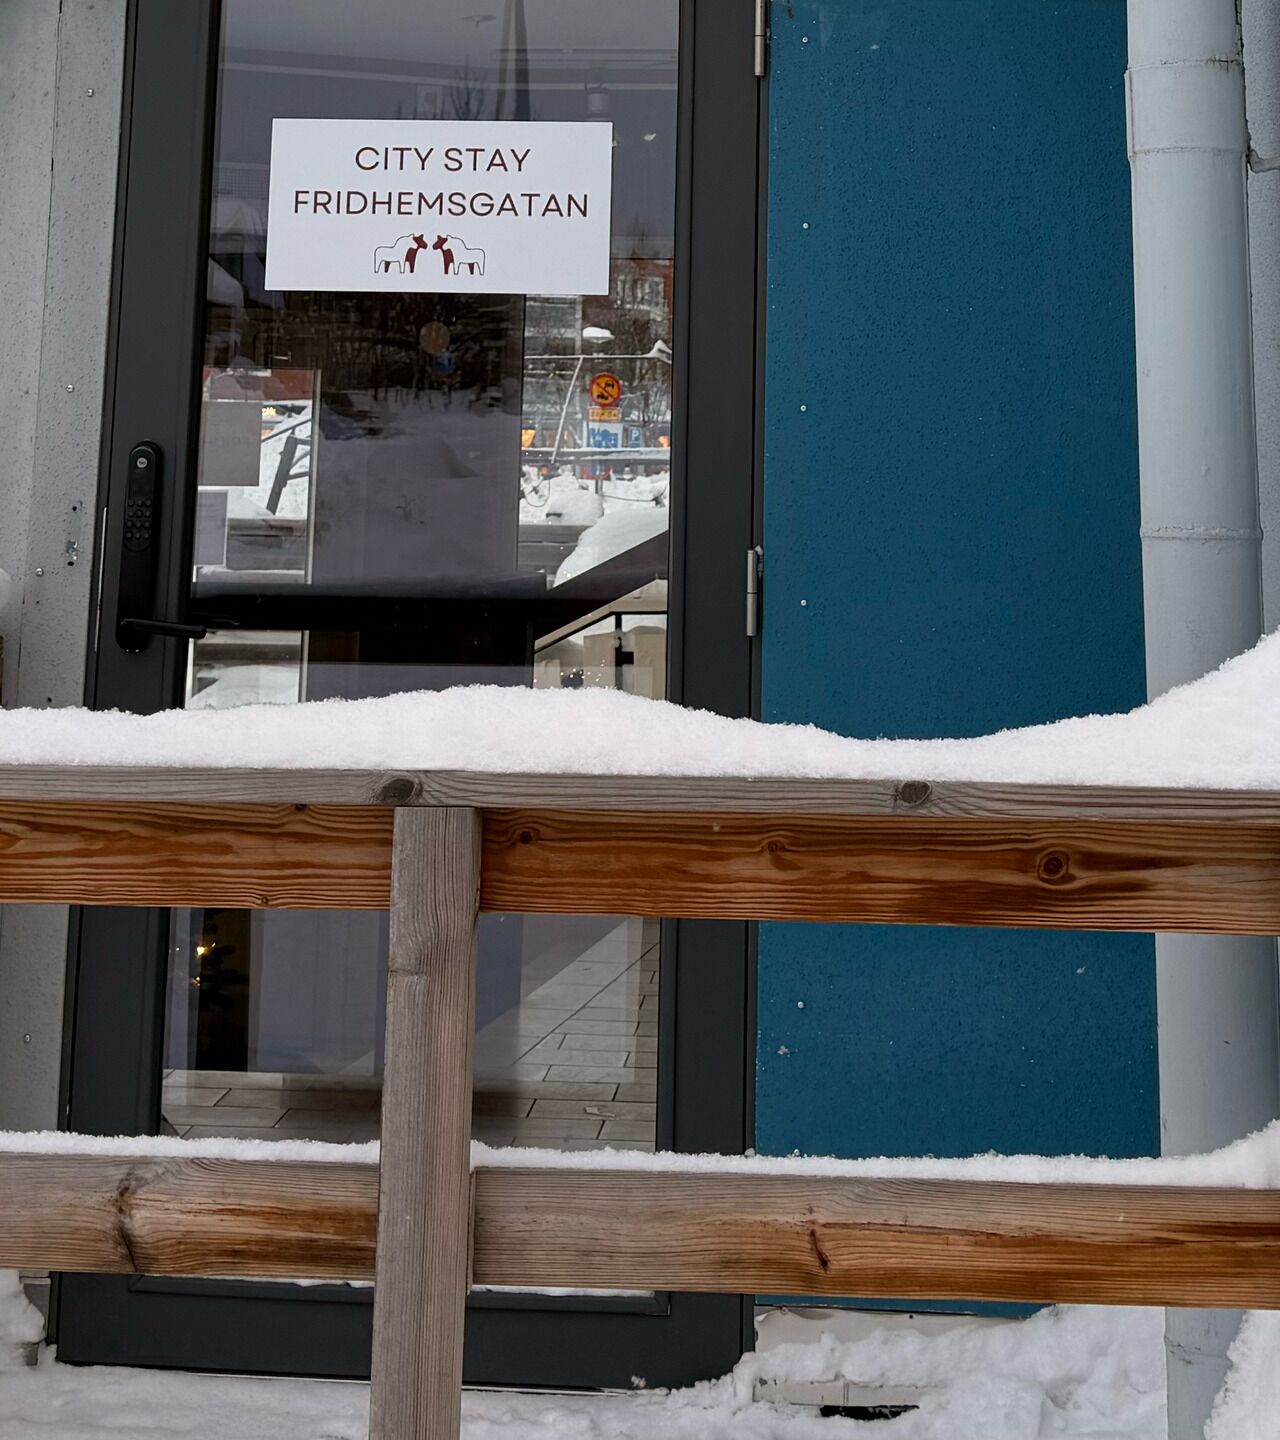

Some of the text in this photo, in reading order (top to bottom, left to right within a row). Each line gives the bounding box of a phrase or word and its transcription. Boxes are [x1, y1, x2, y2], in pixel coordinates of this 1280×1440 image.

[355, 146, 531, 172] CITY STAY
[294, 190, 588, 218] FRIDHEMSGATAN
